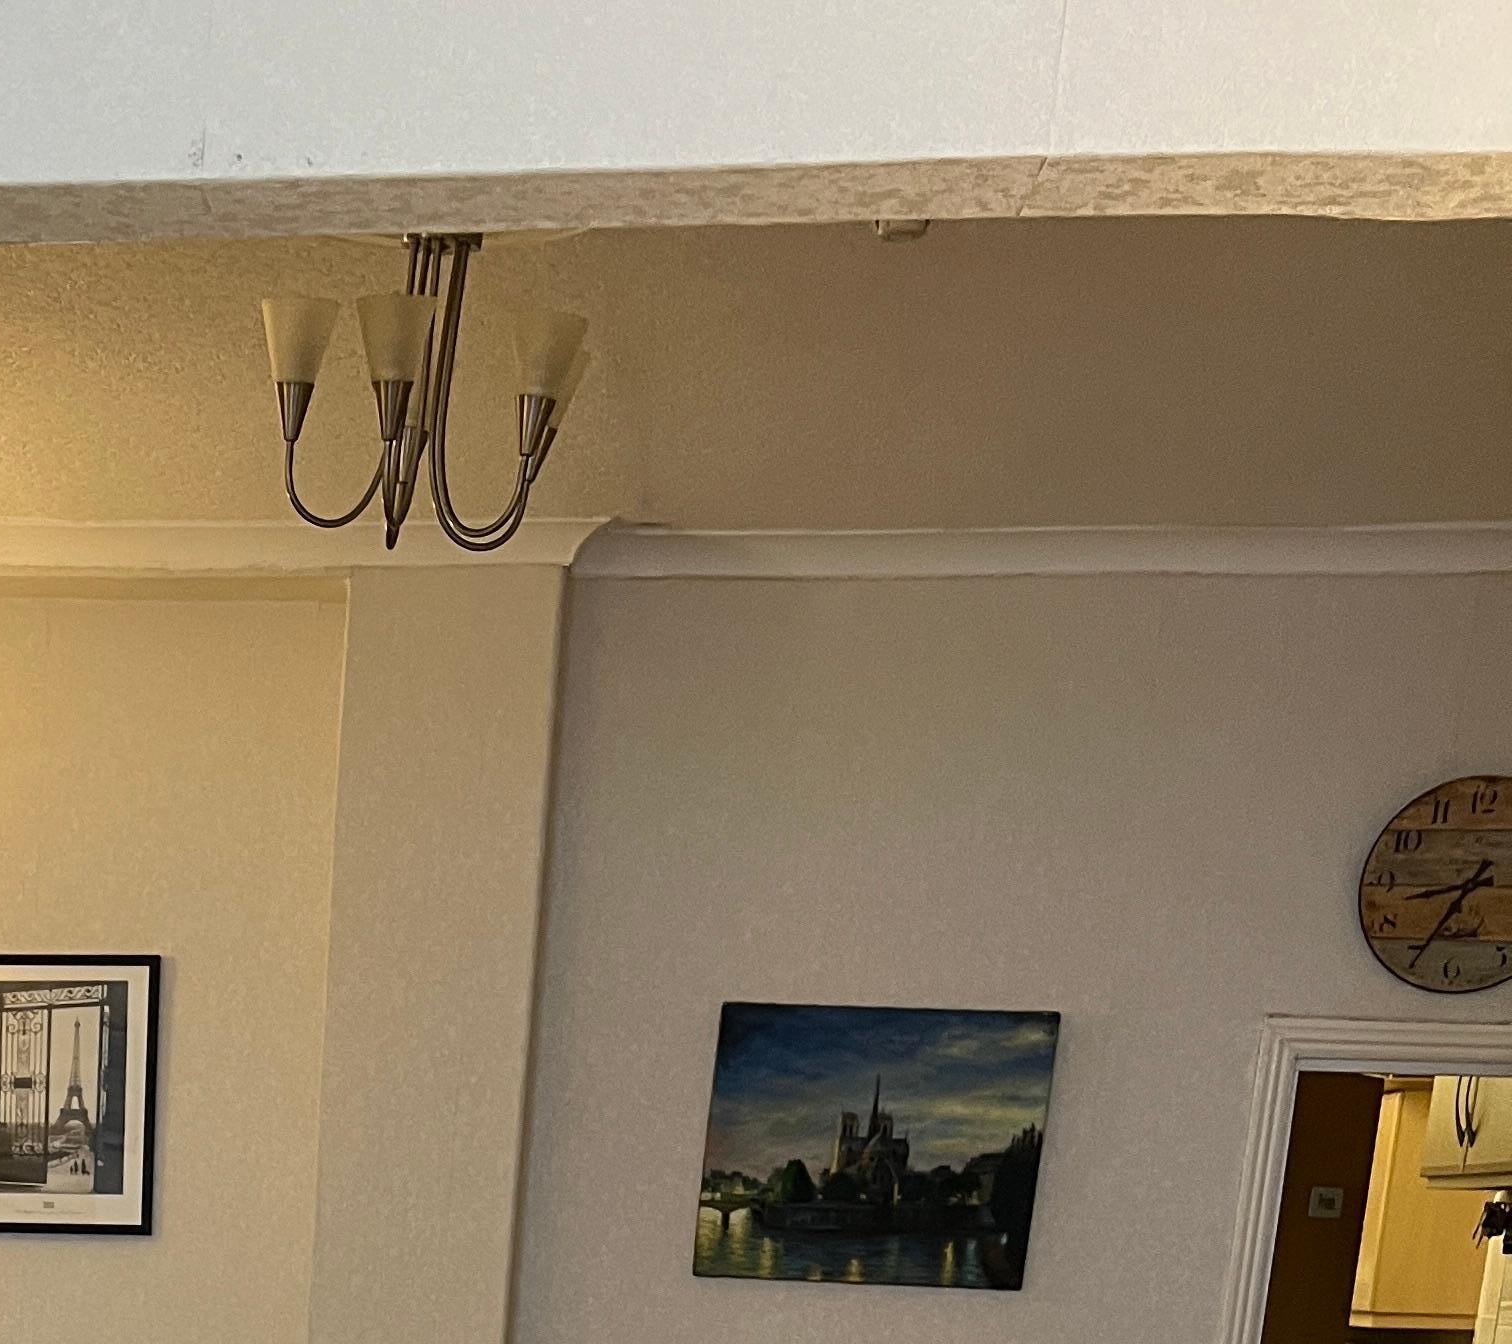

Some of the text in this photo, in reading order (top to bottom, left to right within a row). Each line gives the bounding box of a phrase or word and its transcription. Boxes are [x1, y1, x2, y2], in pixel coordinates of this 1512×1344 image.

[1432, 799, 1450, 824] 11
[1472, 784, 1498, 815] 12
[1394, 829, 1422, 853] 10
